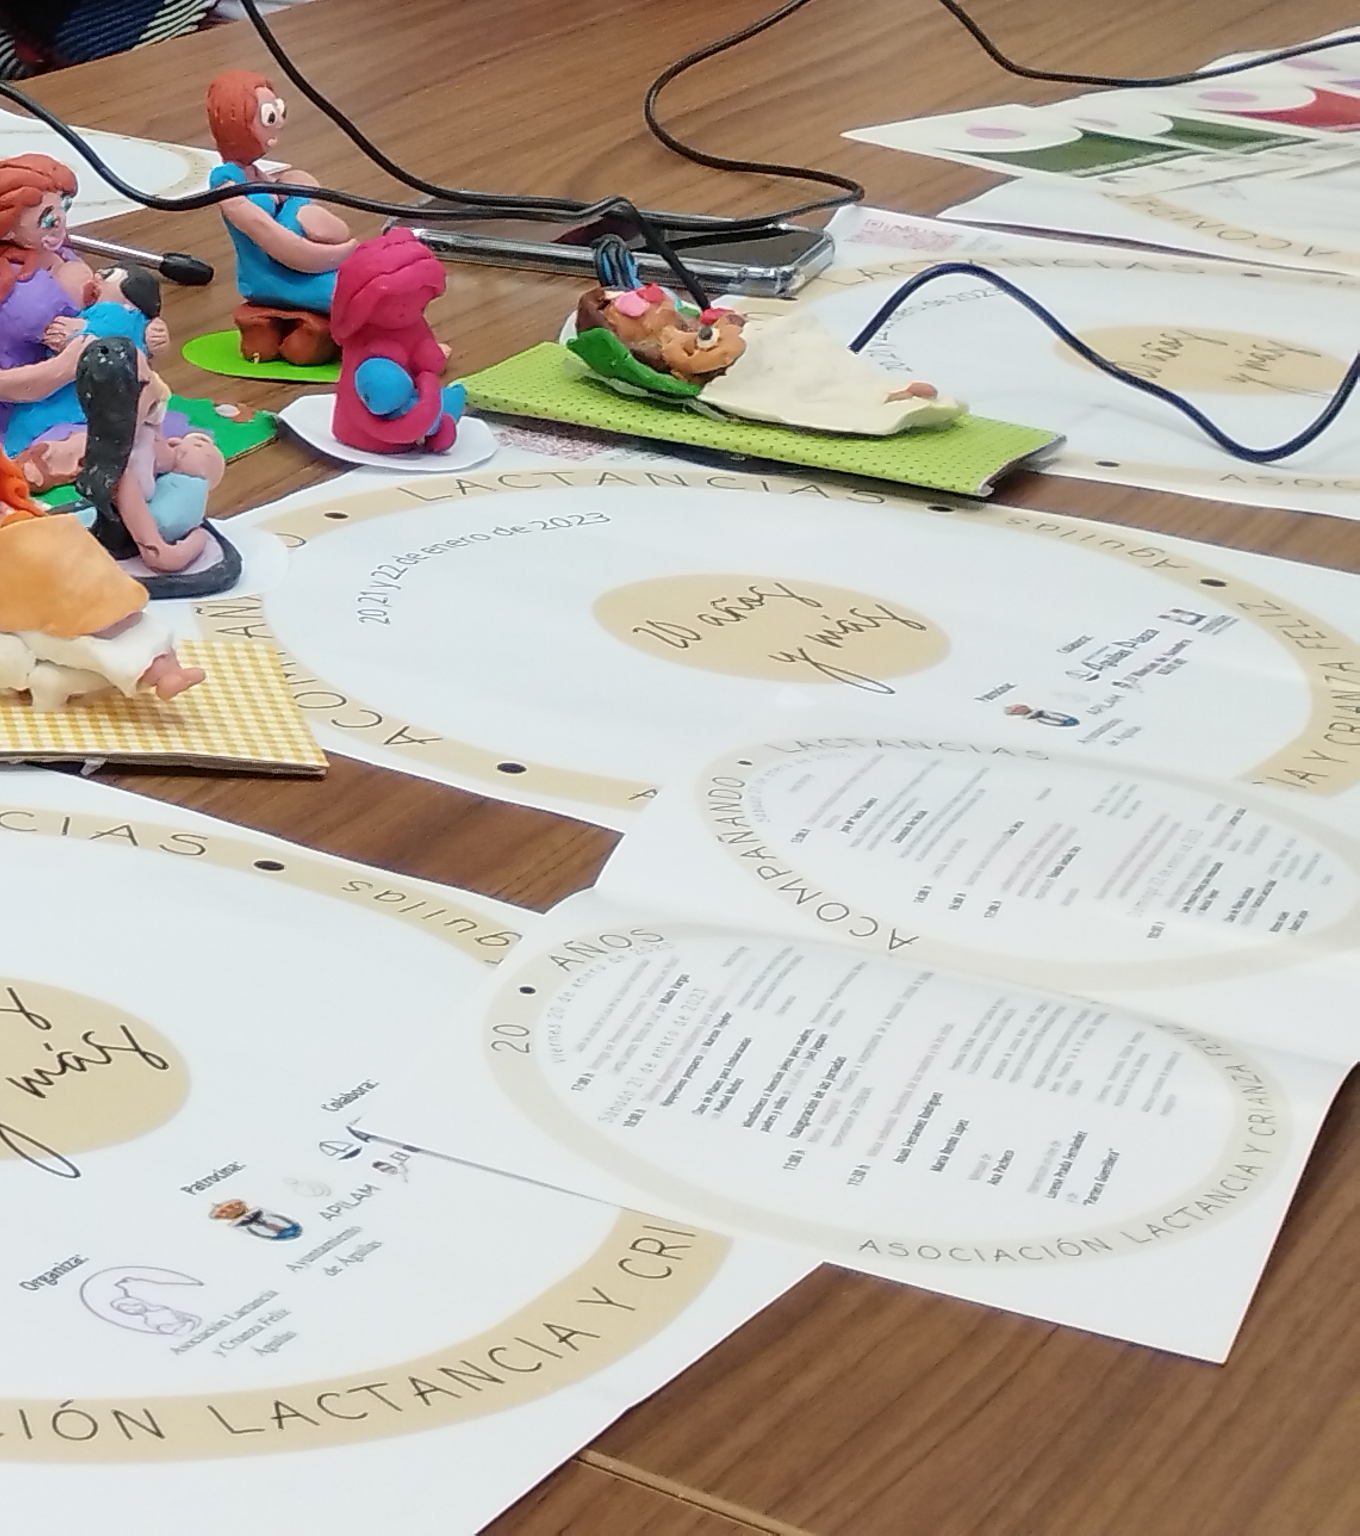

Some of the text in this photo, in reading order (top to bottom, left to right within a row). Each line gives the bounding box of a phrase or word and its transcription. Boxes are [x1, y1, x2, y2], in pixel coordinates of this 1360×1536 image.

[397, 471, 886, 505] LACTANCIAS
[421, 531, 491, 557] enero
[492, 525, 532, 538] de
[530, 511, 611, 532] 2023
[707, 776, 920, 951] ACOMPAÑANDO
[342, 880, 523, 965] guilas
[548, 929, 664, 972] AÑOS
[6, 1025, 169, 1098] más
[491, 1024, 531, 1053] 20
[319, 1183, 381, 1221] APILAM
[858, 1238, 1113, 1263] ASOCIACIÓN
[1119, 1158, 1263, 1244] LACTANCIA
[19, 1254, 89, 1292] Organiza:
[208, 1322, 601, 1435] LACTANCIA
[576, 1287, 636, 1312] Y
